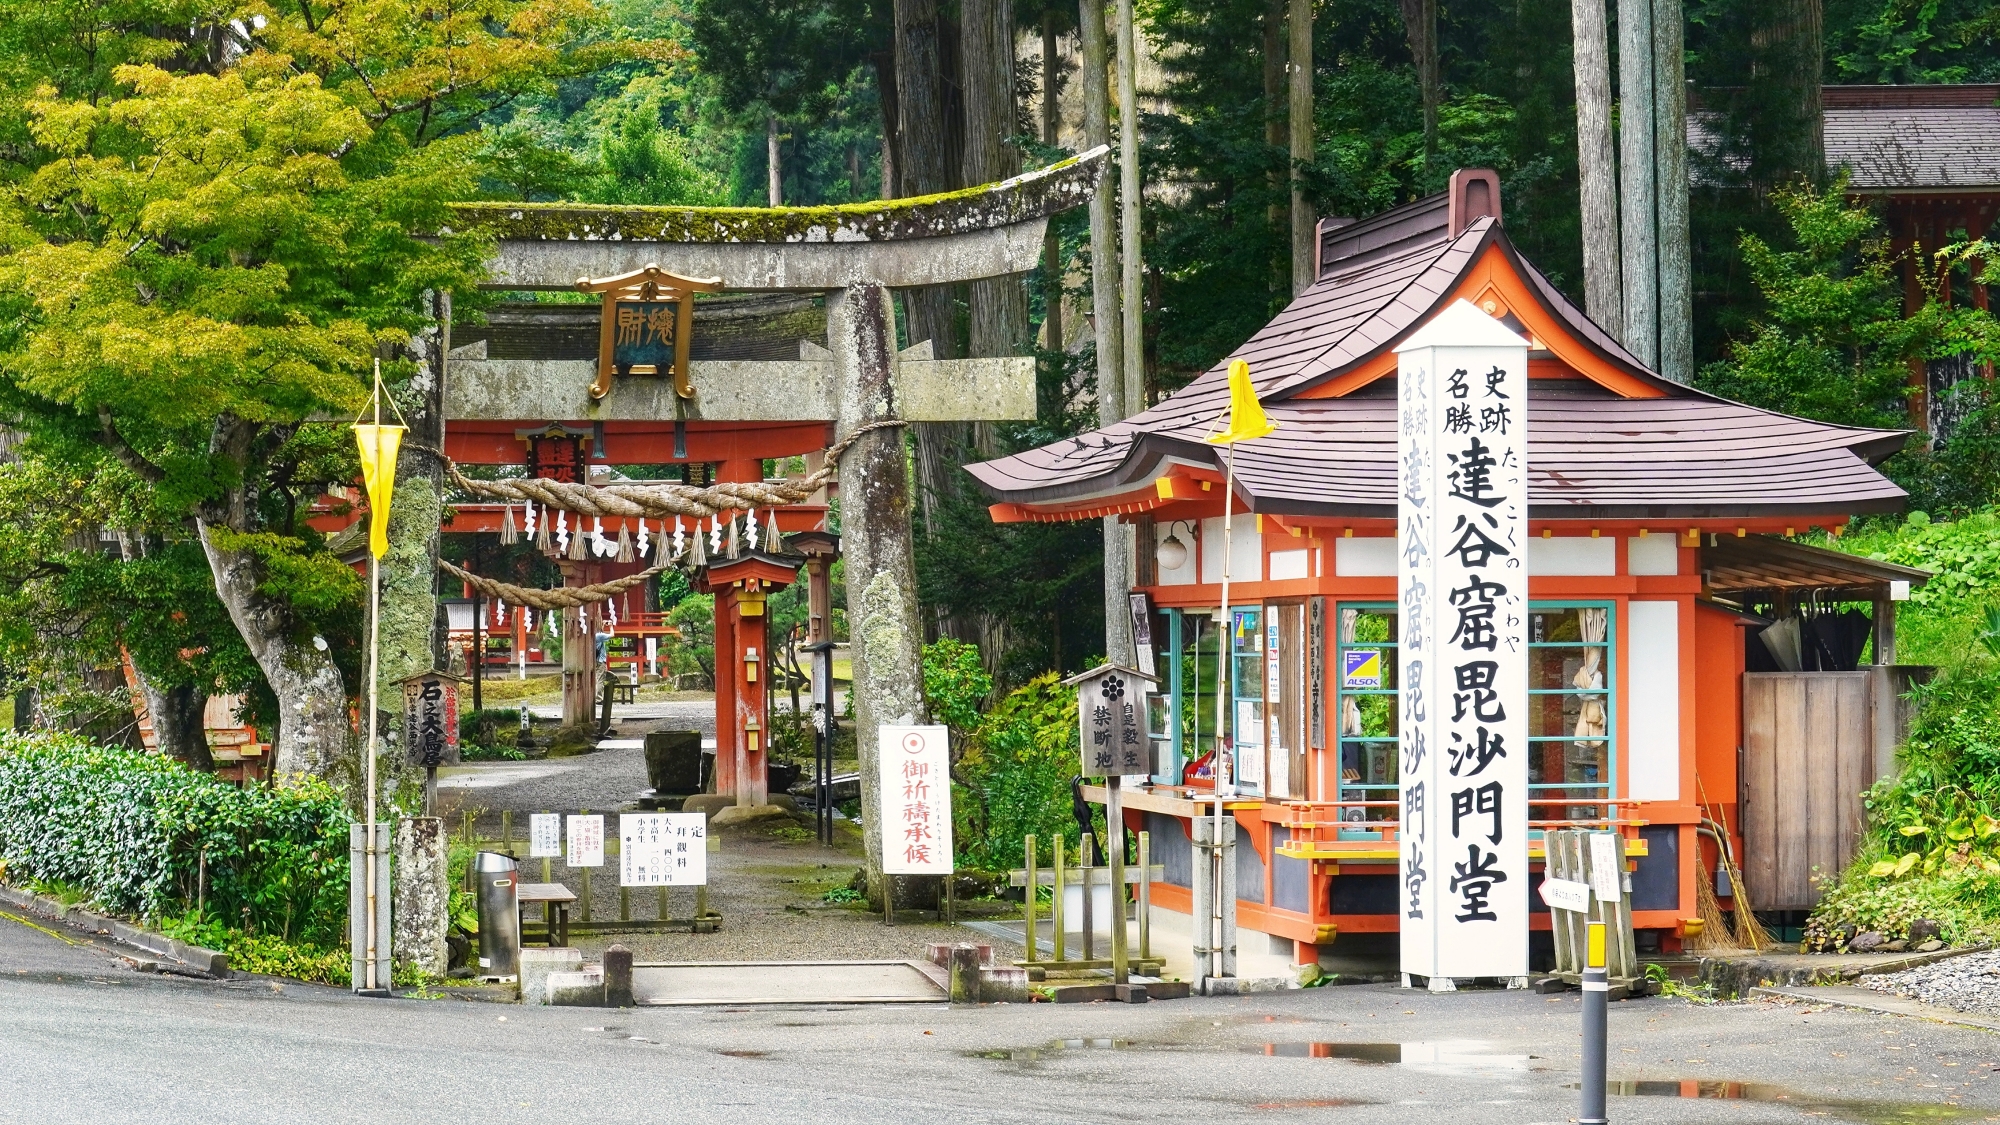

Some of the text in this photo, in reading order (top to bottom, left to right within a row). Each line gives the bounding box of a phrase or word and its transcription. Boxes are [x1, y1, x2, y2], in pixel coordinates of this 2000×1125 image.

[1403, 372, 1415, 437] 名勝
[1416, 366, 1428, 436] 史跡
[1443, 368, 1476, 436] 名勝
[1480, 365, 1512, 436] 史跡
[1502, 446, 1520, 653] たっこくの いわや
[1403, 438, 1428, 920] 達谷窟毘沙門堂
[1443, 436, 1509, 924] 達谷窟毘沙門堂
[419, 680, 446, 767] 石之大鳥居
[1122, 702, 1140, 768] 自是殺生
[637, 818, 646, 882] 小学生 無料
[650, 817, 659, 843] 中高生
[664, 817, 672, 834] 大人
[691, 825, 703, 838] 定
